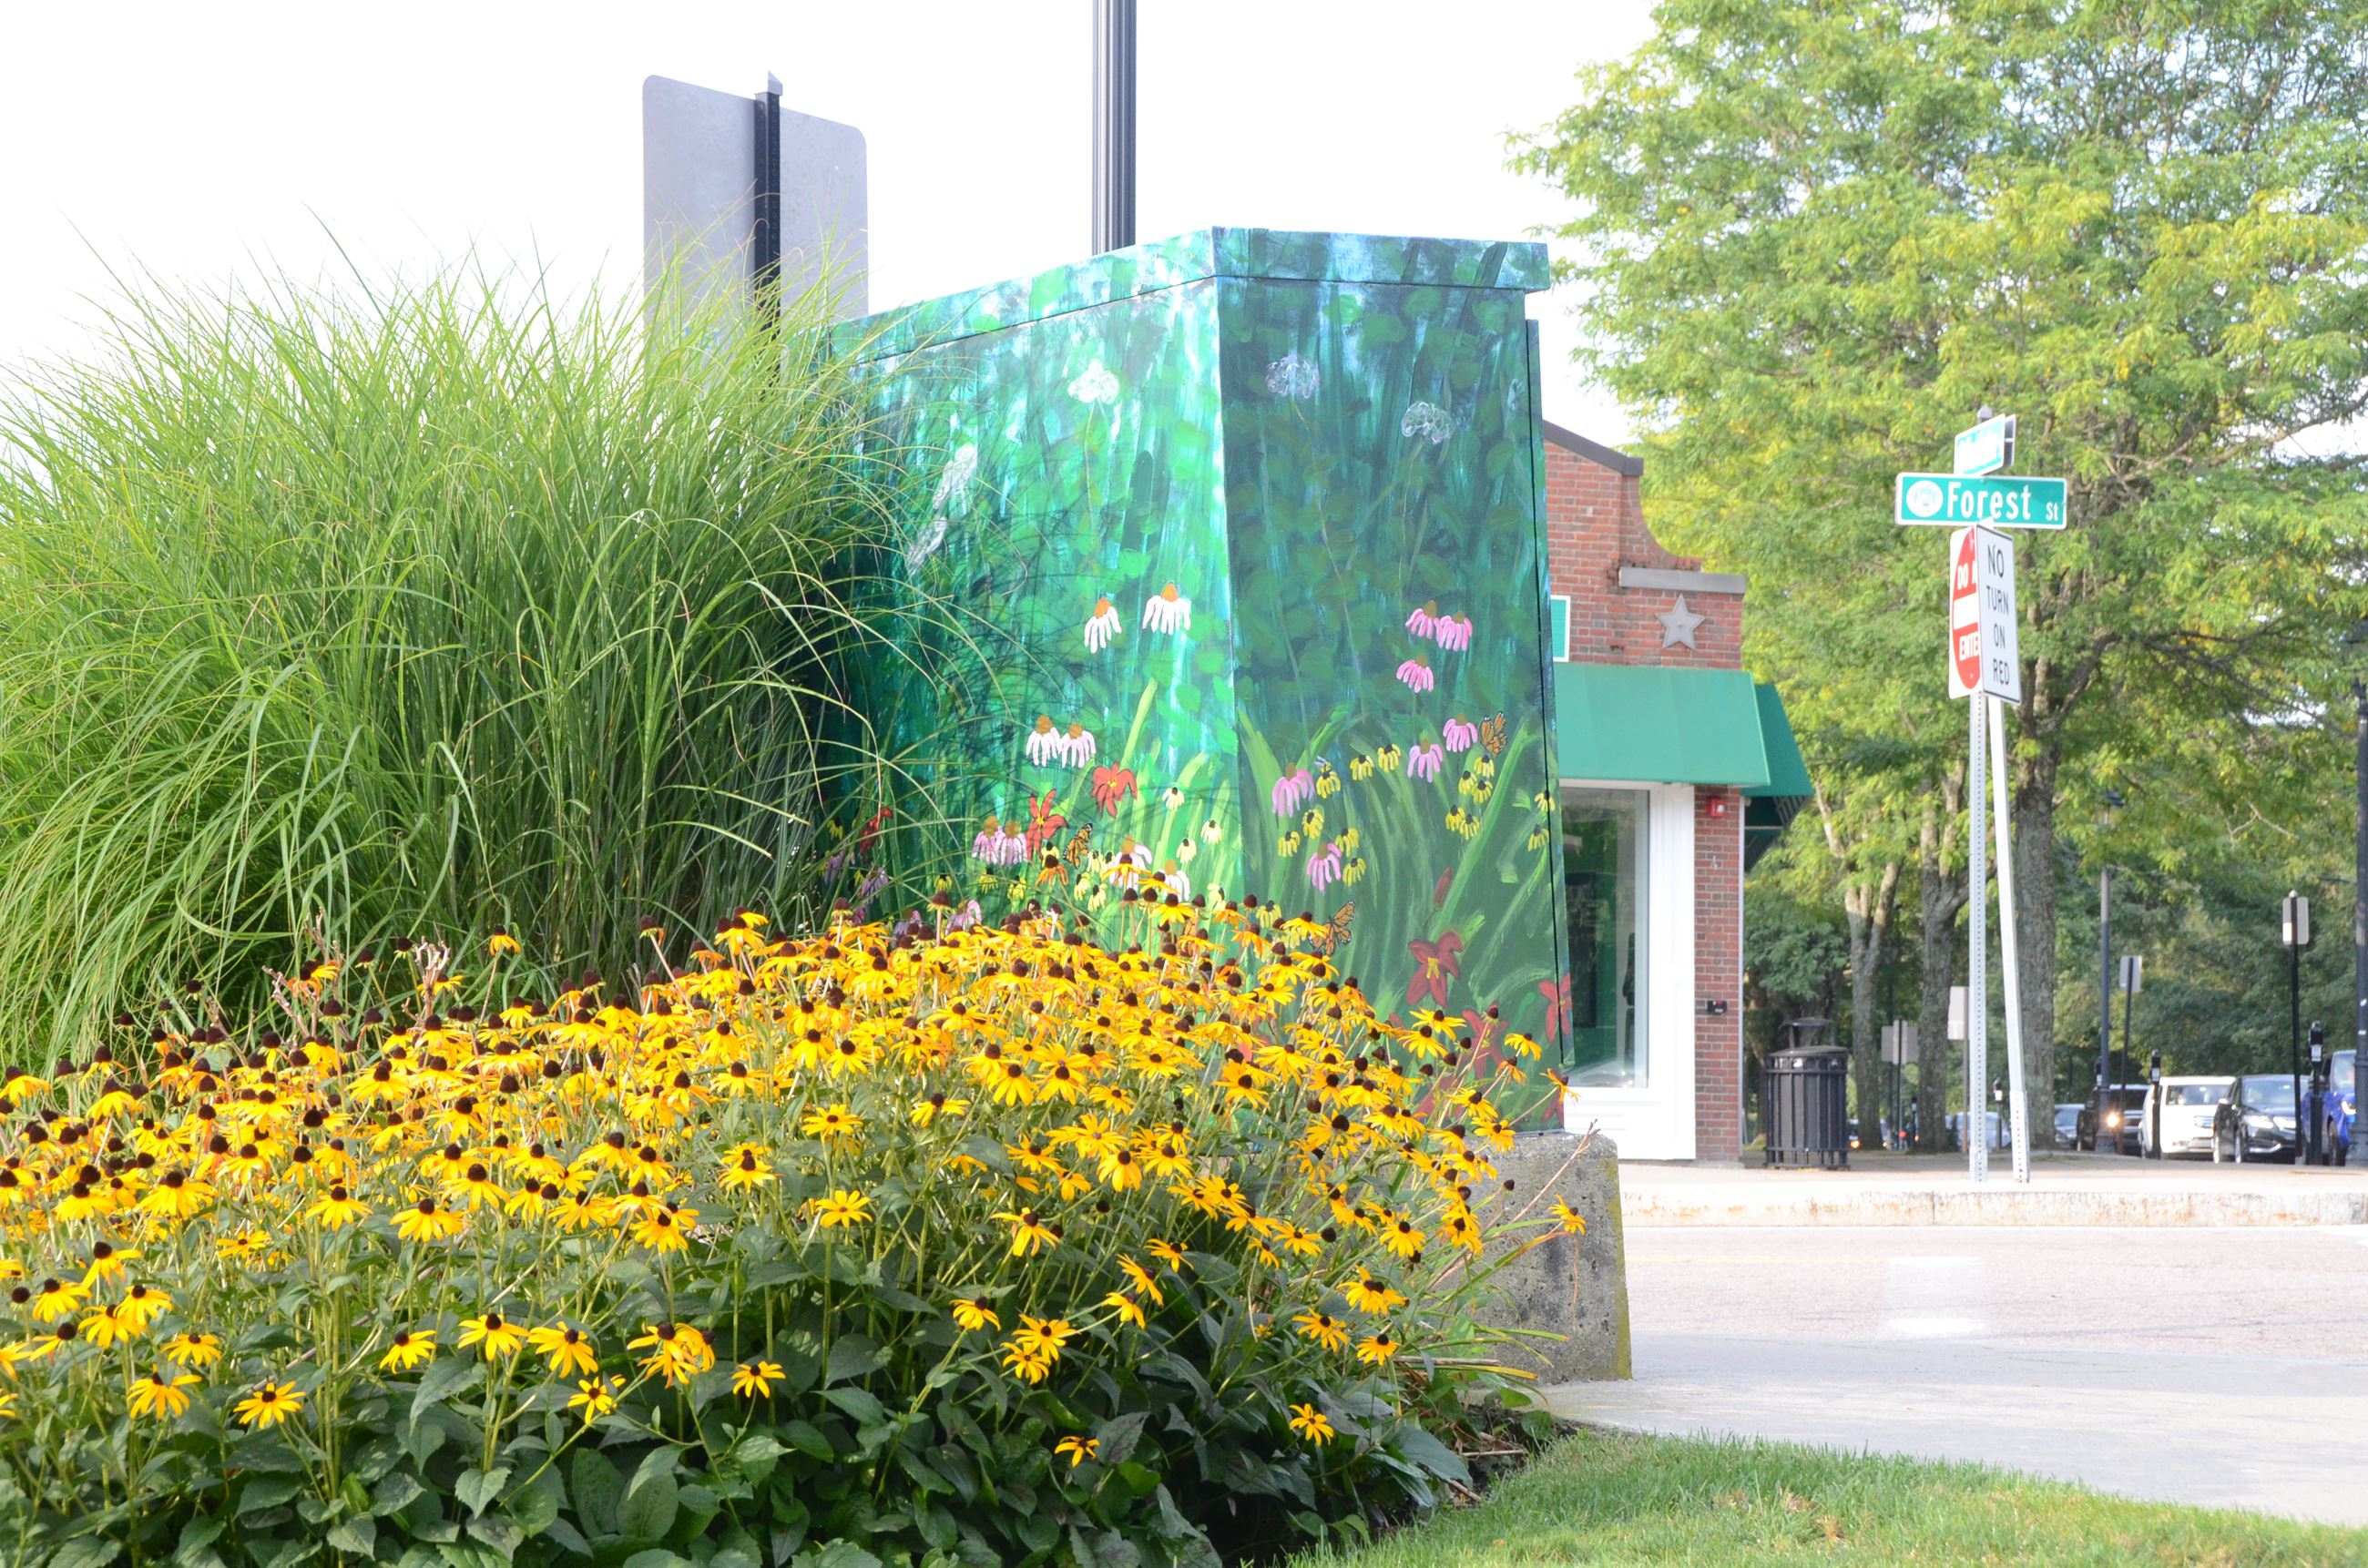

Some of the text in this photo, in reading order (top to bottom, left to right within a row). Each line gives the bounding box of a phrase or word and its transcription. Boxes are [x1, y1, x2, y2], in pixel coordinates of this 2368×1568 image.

[1947, 482, 2031, 520] Forest
[2046, 502, 2059, 521] St
[1987, 544, 2005, 578] NO
[1957, 562, 1969, 591] DO
[1986, 585, 2010, 616] TURN
[1959, 631, 1979, 661] ENTE
[1994, 623, 2006, 649] ON
[1993, 657, 2010, 685] RED
